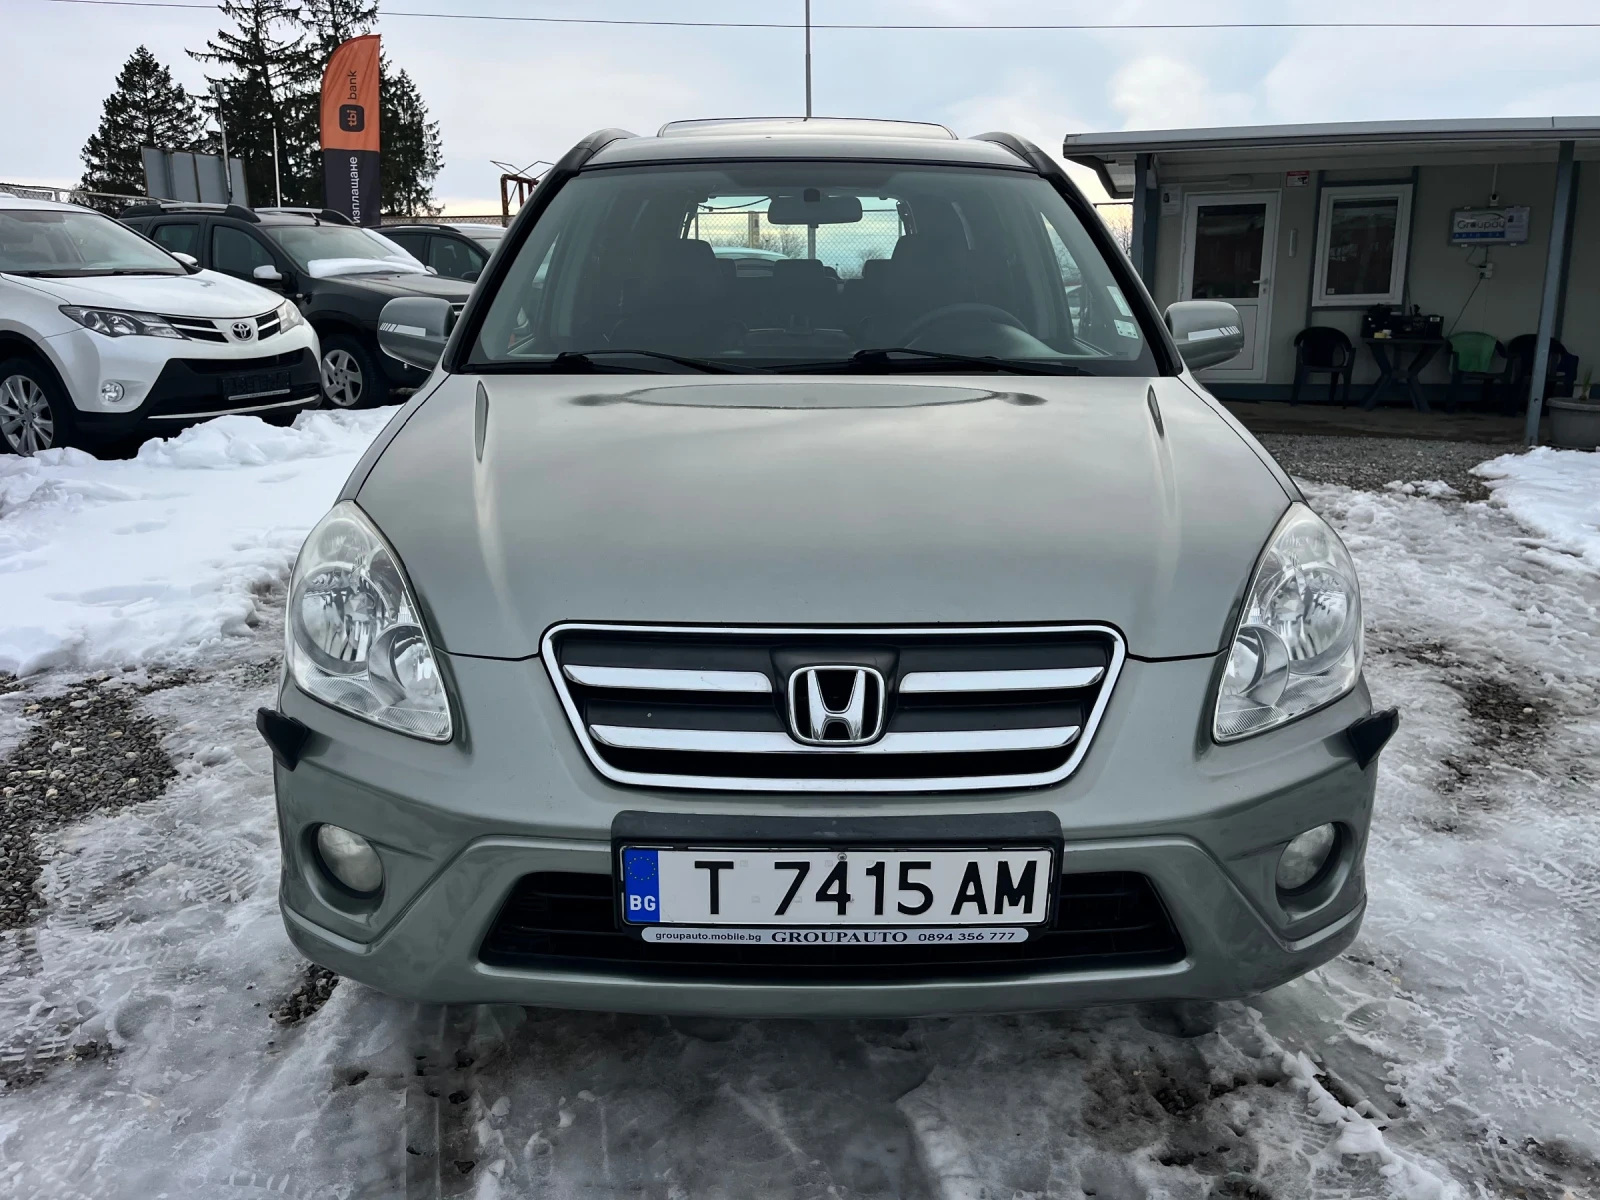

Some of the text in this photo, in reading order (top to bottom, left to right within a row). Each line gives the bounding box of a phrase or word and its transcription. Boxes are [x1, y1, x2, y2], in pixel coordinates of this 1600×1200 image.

[347, 70, 357, 126] tbi bank
[350, 156, 361, 224] изплащане
[629, 894, 656, 911] BG
[694, 860, 1038, 916] T 7415 AM
[655, 931, 1015, 943] groupauto.mobile.bg GROUPAUTO 0894 356 777
